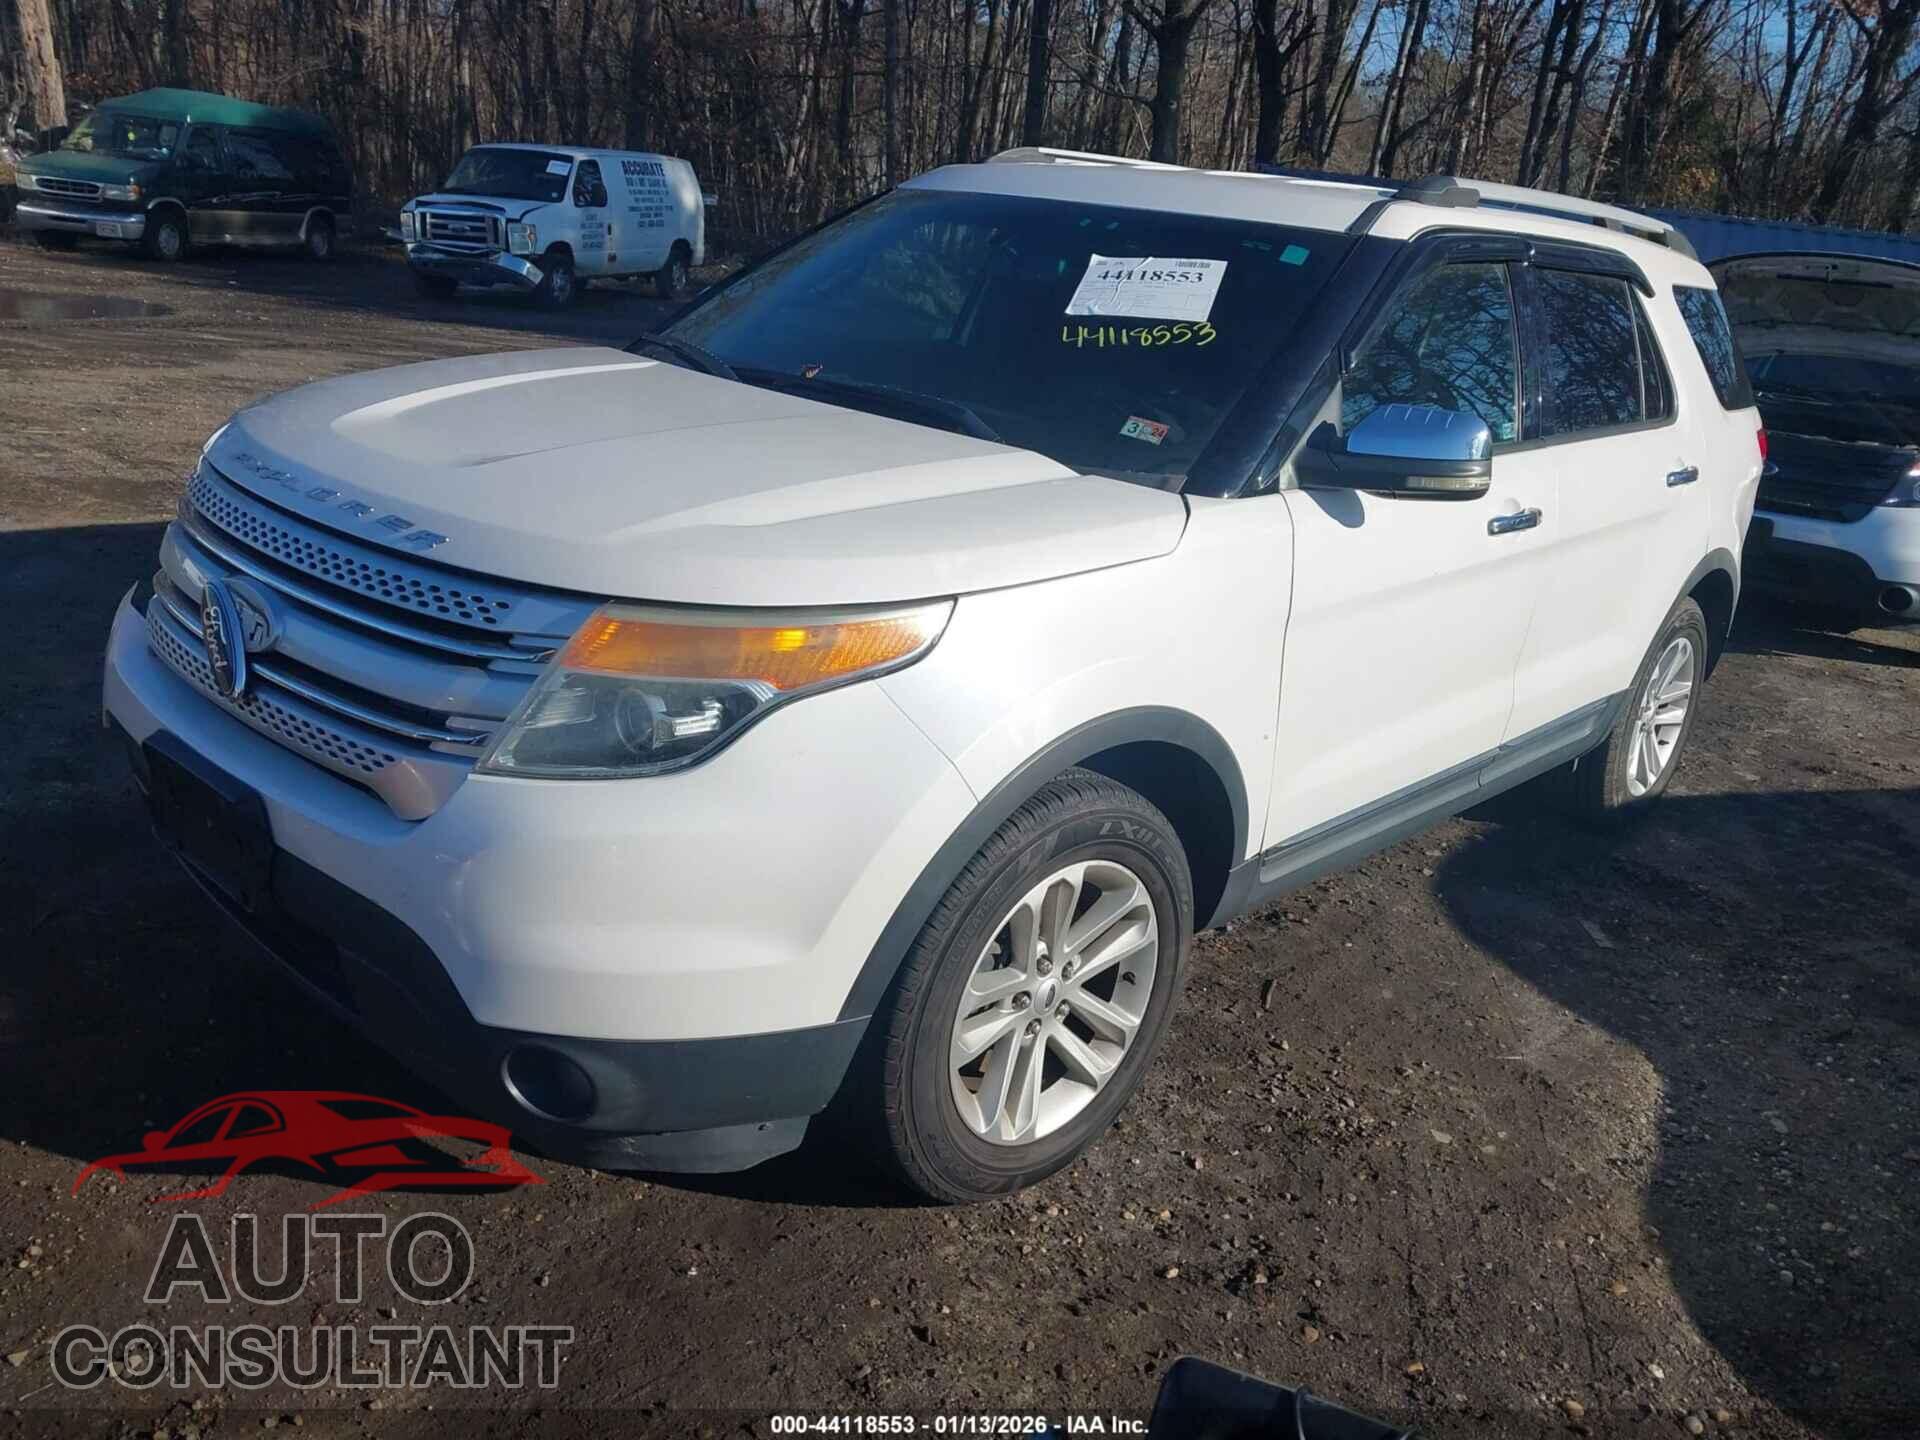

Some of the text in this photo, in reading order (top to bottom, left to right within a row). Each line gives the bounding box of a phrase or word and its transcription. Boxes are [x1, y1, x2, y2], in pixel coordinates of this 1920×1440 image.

[621, 160, 666, 177] ACCURATE
[1097, 269, 1204, 284] 44118553
[1062, 321, 1217, 348] 44118553
[203, 605, 228, 673] Ford
